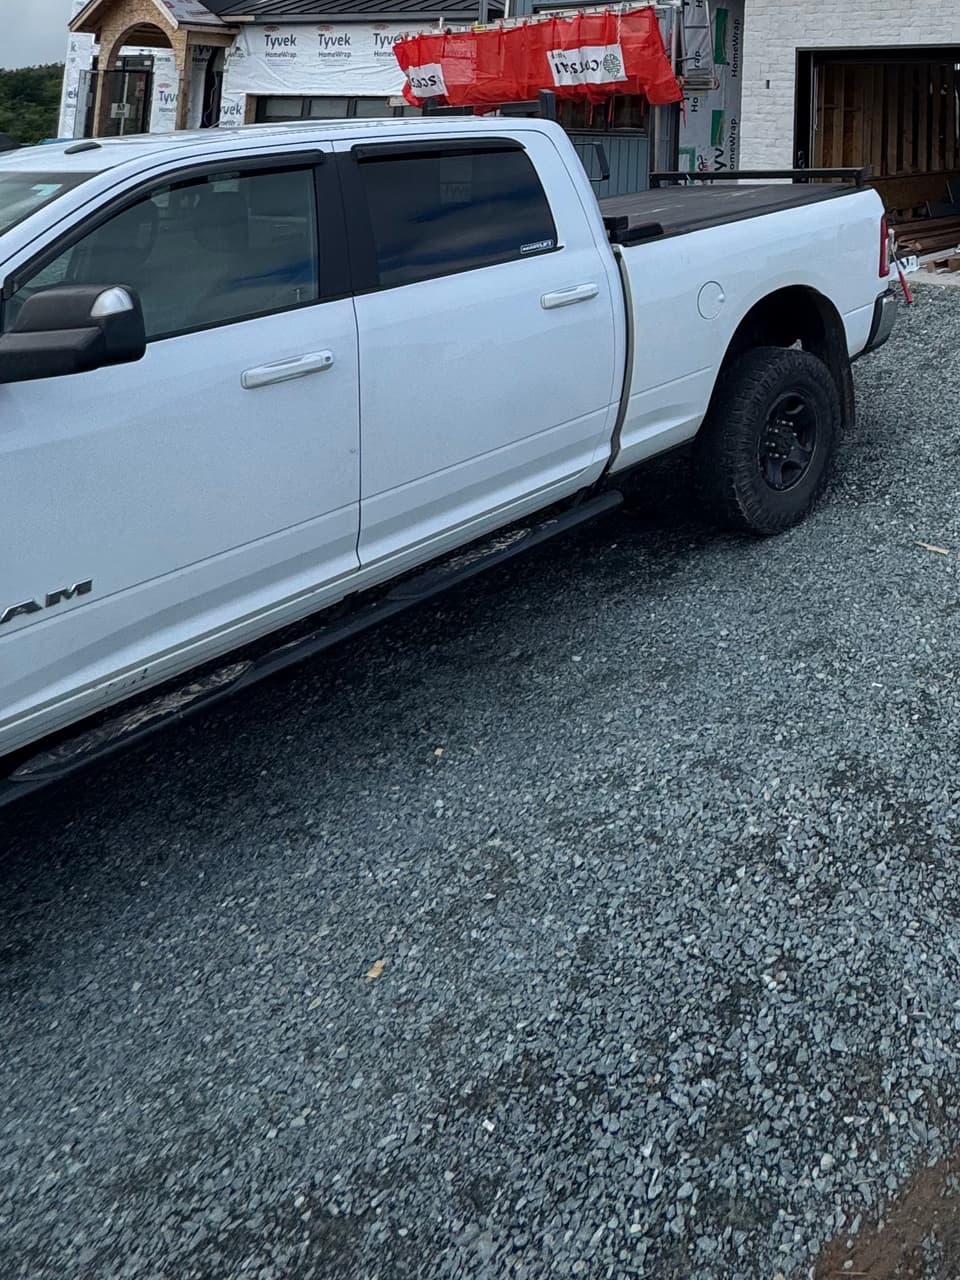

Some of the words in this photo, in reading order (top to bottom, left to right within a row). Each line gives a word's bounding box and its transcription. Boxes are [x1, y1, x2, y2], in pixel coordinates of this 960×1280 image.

[264, 33, 296, 49] Tyvek
[318, 33, 350, 49] Tyvek
[729, 117, 737, 170] omeWrap
[0, 577, 93, 624] AM
